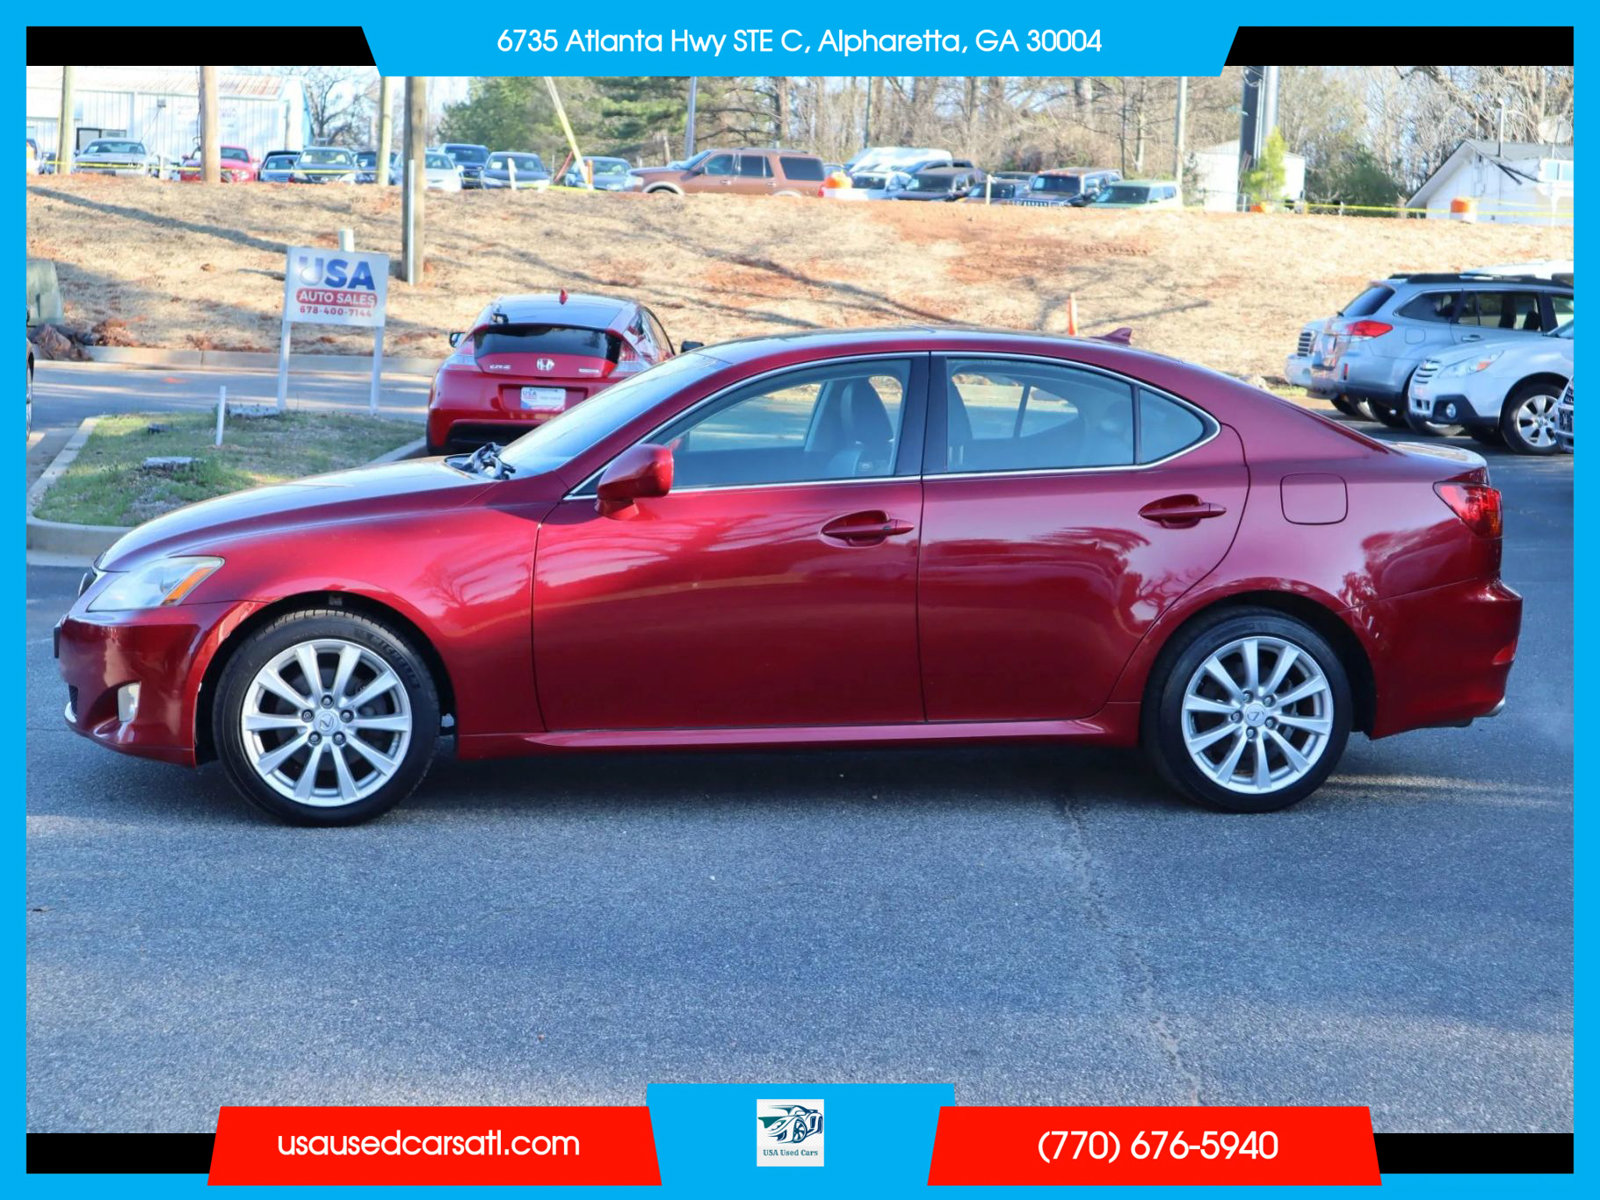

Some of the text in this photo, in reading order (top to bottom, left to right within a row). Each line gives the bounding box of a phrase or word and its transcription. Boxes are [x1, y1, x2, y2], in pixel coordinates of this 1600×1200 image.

[298, 256, 376, 290] USA
[299, 290, 375, 306] AUTO SALES
